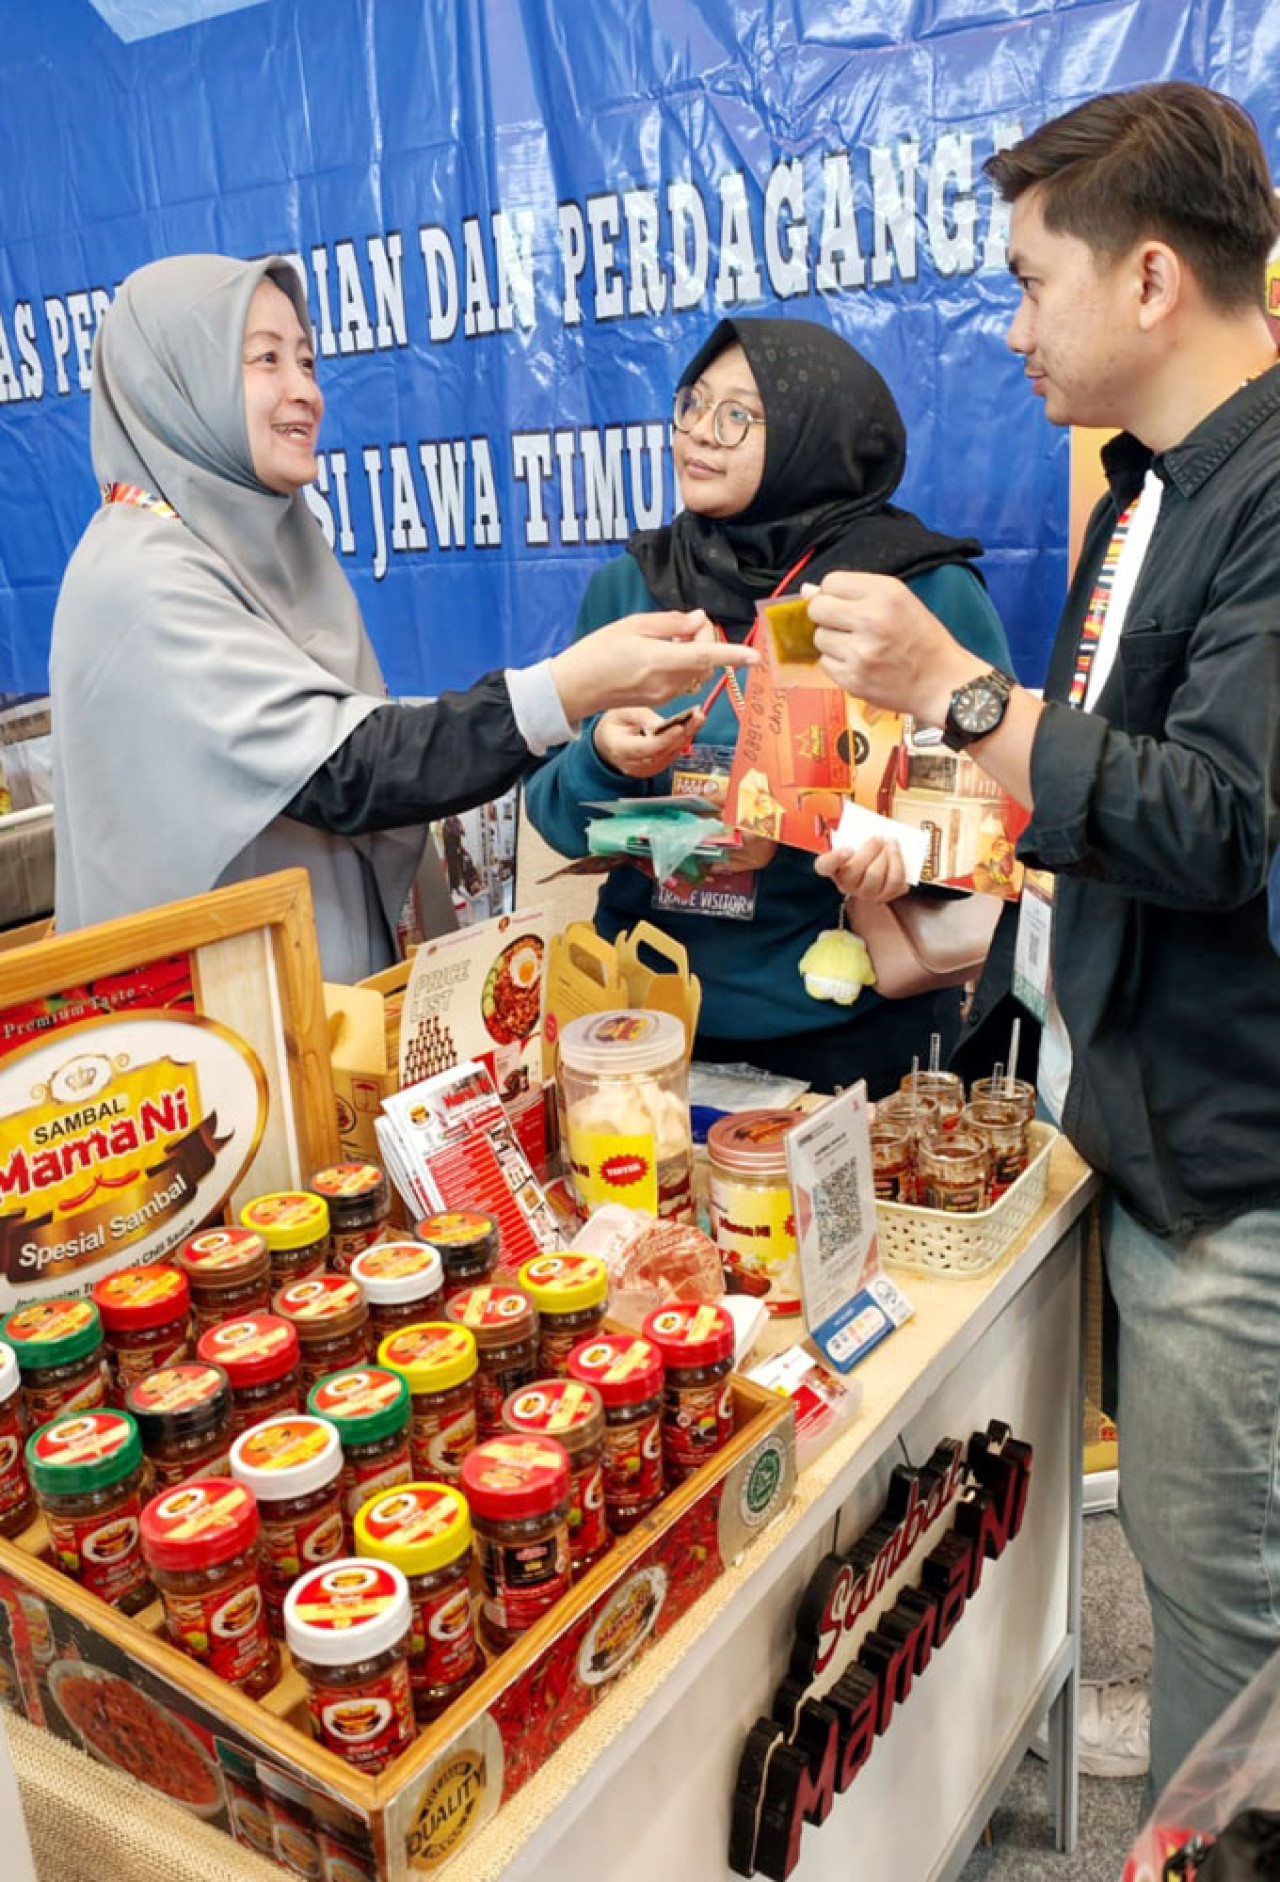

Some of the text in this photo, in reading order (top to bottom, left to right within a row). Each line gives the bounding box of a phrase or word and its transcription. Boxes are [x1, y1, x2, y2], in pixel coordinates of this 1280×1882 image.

[418, 208, 538, 343] DAN
[362, 436, 502, 580] JAWA
[511, 420, 686, 546] TIMU
[3, 1003, 85, 1039] Premium
[33, 1098, 125, 1145] SAMBAL
[18, 1172, 189, 1272] Spesial Sambal
[813, 1438, 963, 1677] Sambal
[405, 1753, 487, 1869] QUALITY
